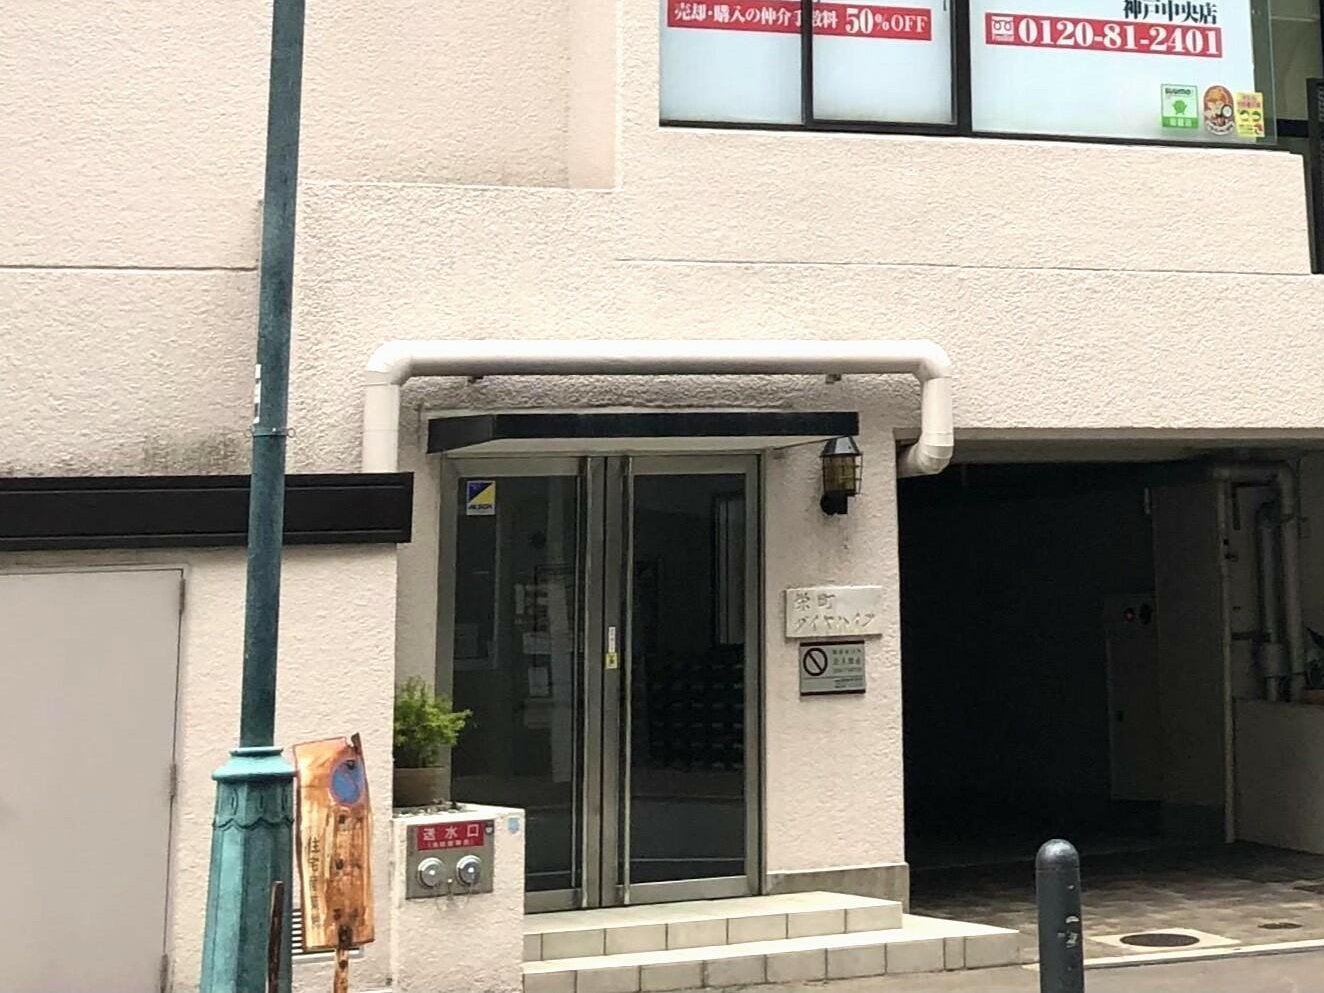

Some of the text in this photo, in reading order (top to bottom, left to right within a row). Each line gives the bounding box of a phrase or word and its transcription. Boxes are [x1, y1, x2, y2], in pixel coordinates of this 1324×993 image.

[1017, 17, 1221, 55] 0120-81-2401
[423, 823, 480, 841] 送水口
